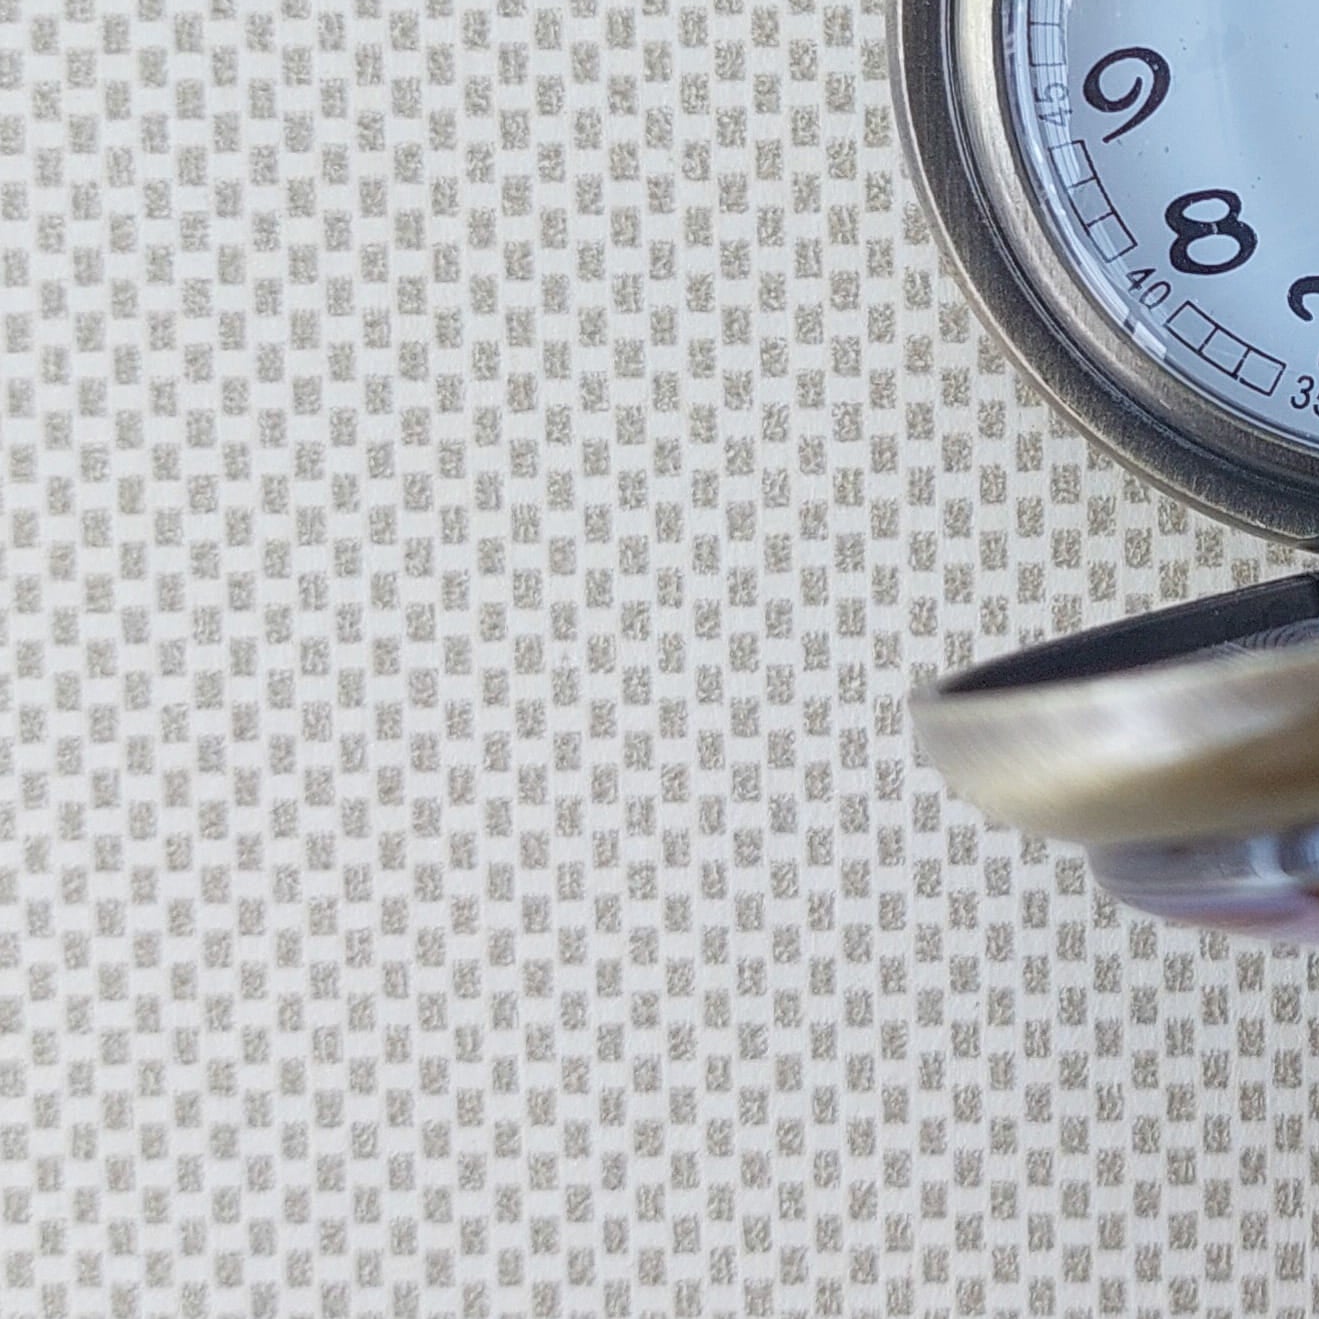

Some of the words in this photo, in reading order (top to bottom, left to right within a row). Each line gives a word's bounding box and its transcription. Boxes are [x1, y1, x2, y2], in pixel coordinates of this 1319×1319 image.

[1034, 82, 1073, 127] 45
[1082, 46, 1172, 143] 9
[1164, 188, 1258, 275] 8
[1125, 267, 1172, 310] 40
